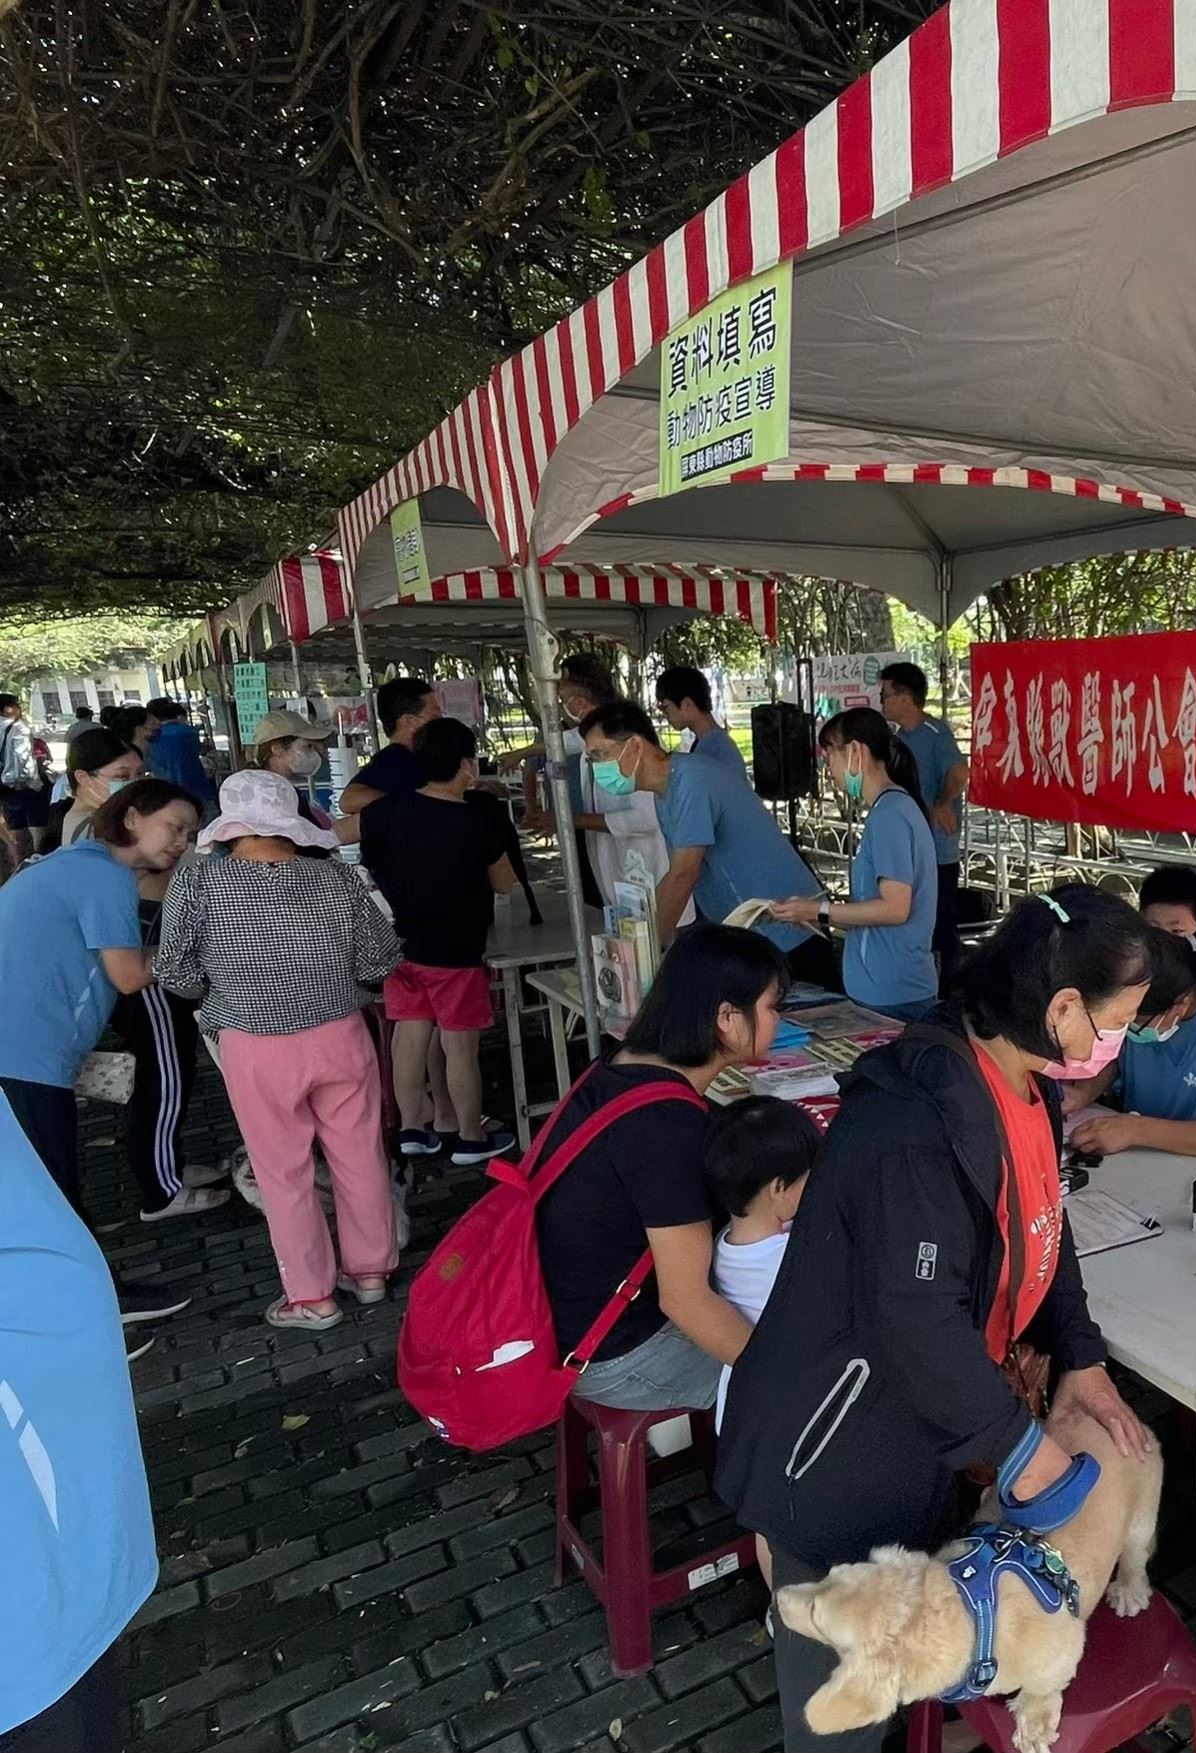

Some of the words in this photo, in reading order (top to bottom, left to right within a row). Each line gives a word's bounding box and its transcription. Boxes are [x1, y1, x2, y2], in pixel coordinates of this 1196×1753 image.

[668, 287, 776, 398] 資料填寫
[667, 364, 775, 450] 動物防疫宣導
